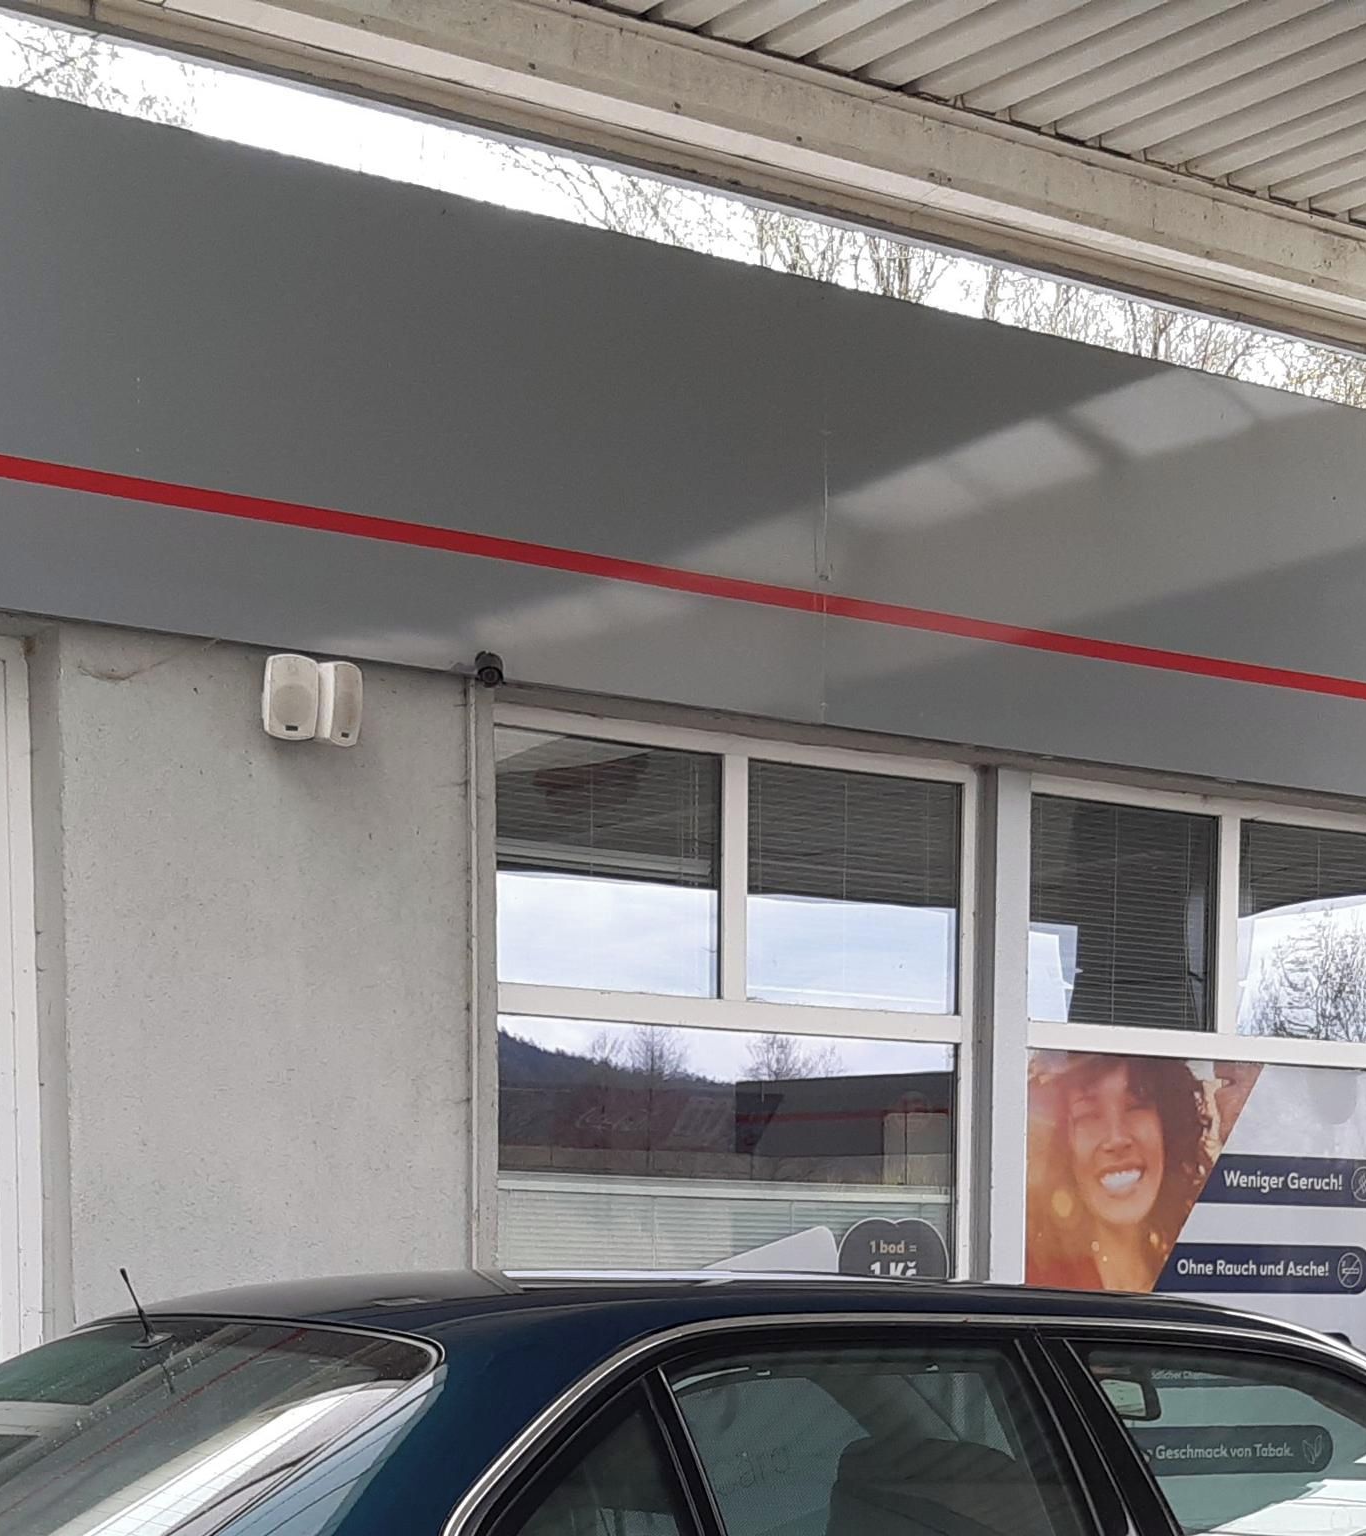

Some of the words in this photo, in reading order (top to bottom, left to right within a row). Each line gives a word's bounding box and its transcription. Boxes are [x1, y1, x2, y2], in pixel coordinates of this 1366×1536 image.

[1223, 1170, 1285, 1193] Weniger
[1287, 1172, 1343, 1191] Geruch!
[869, 1240, 876, 1254] 1
[879, 1240, 905, 1254] bod
[1176, 1259, 1214, 1276] Ohne
[1216, 1259, 1257, 1276] Rauch
[1260, 1260, 1284, 1277] und
[1286, 1261, 1330, 1277] Asche!
[1155, 1444, 1228, 1460] Geschmack
[1230, 1446, 1252, 1458] von
[1253, 1442, 1294, 1457] Tabak.
